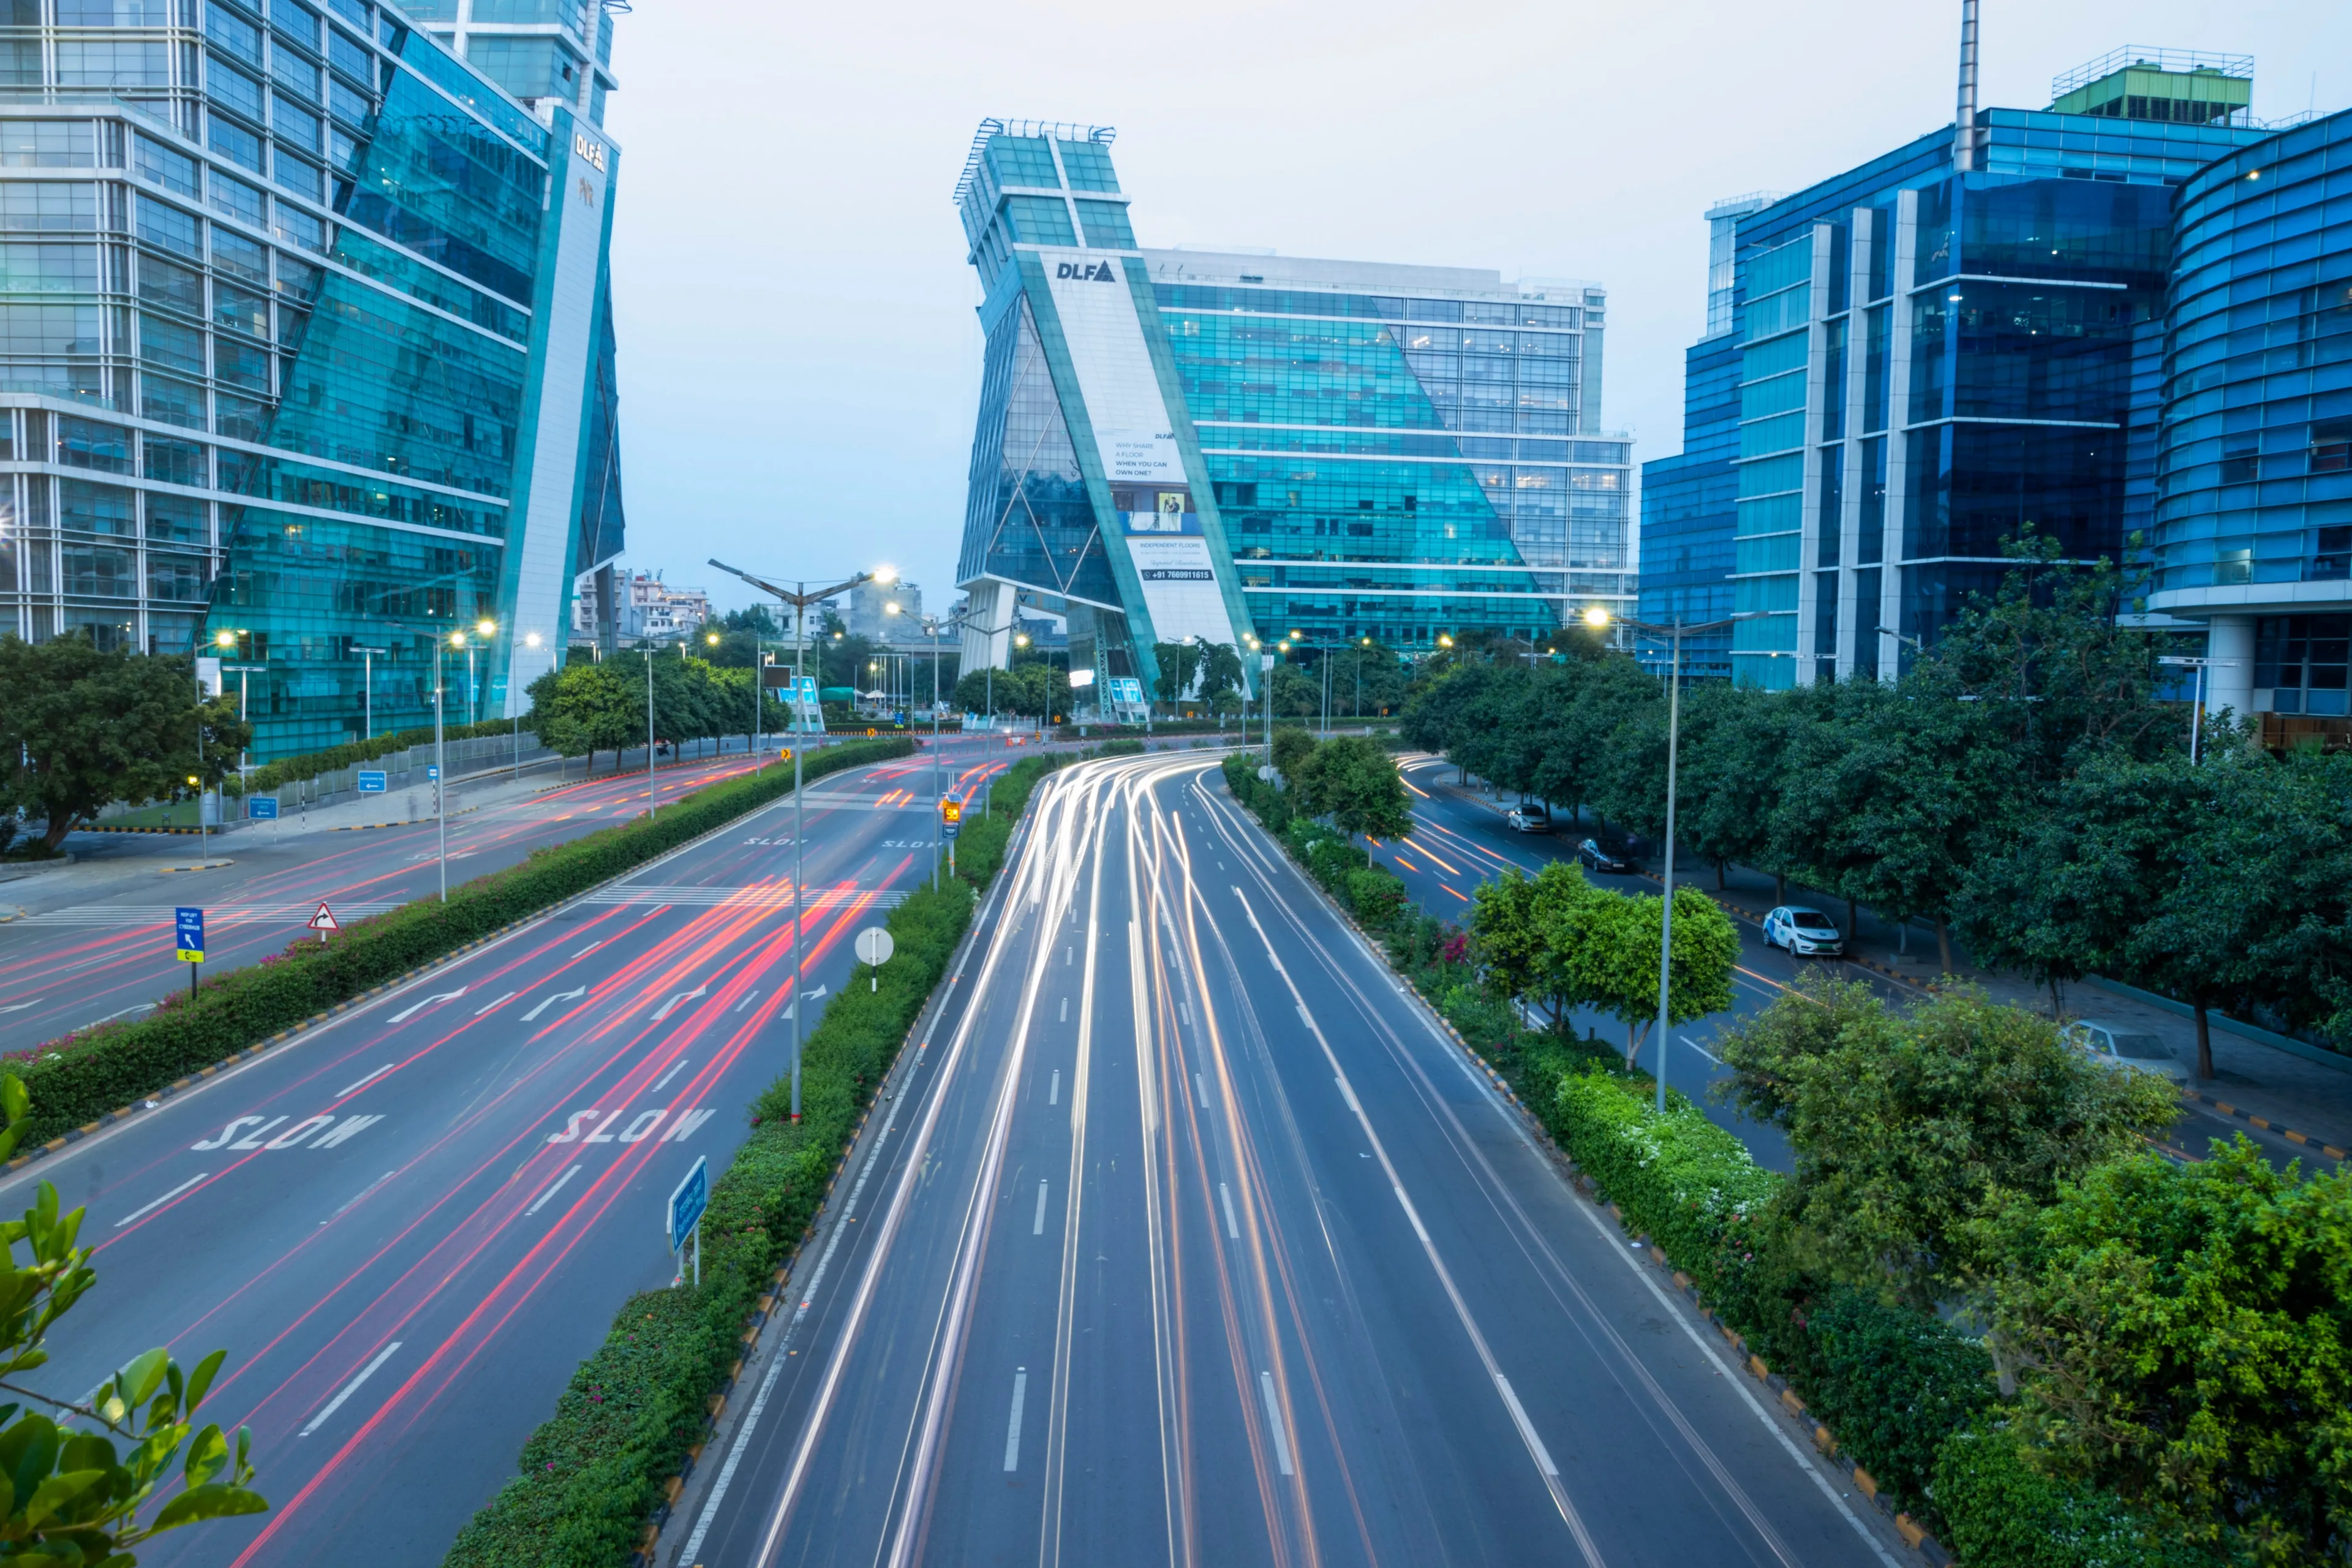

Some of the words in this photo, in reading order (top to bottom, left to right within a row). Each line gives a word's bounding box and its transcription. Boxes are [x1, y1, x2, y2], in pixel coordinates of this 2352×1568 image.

[576, 133, 595, 164] DLF
[1057, 263, 1097, 281] DLF
[190, 1115, 386, 1150] SLOW
[547, 1109, 717, 1144] SLOW
